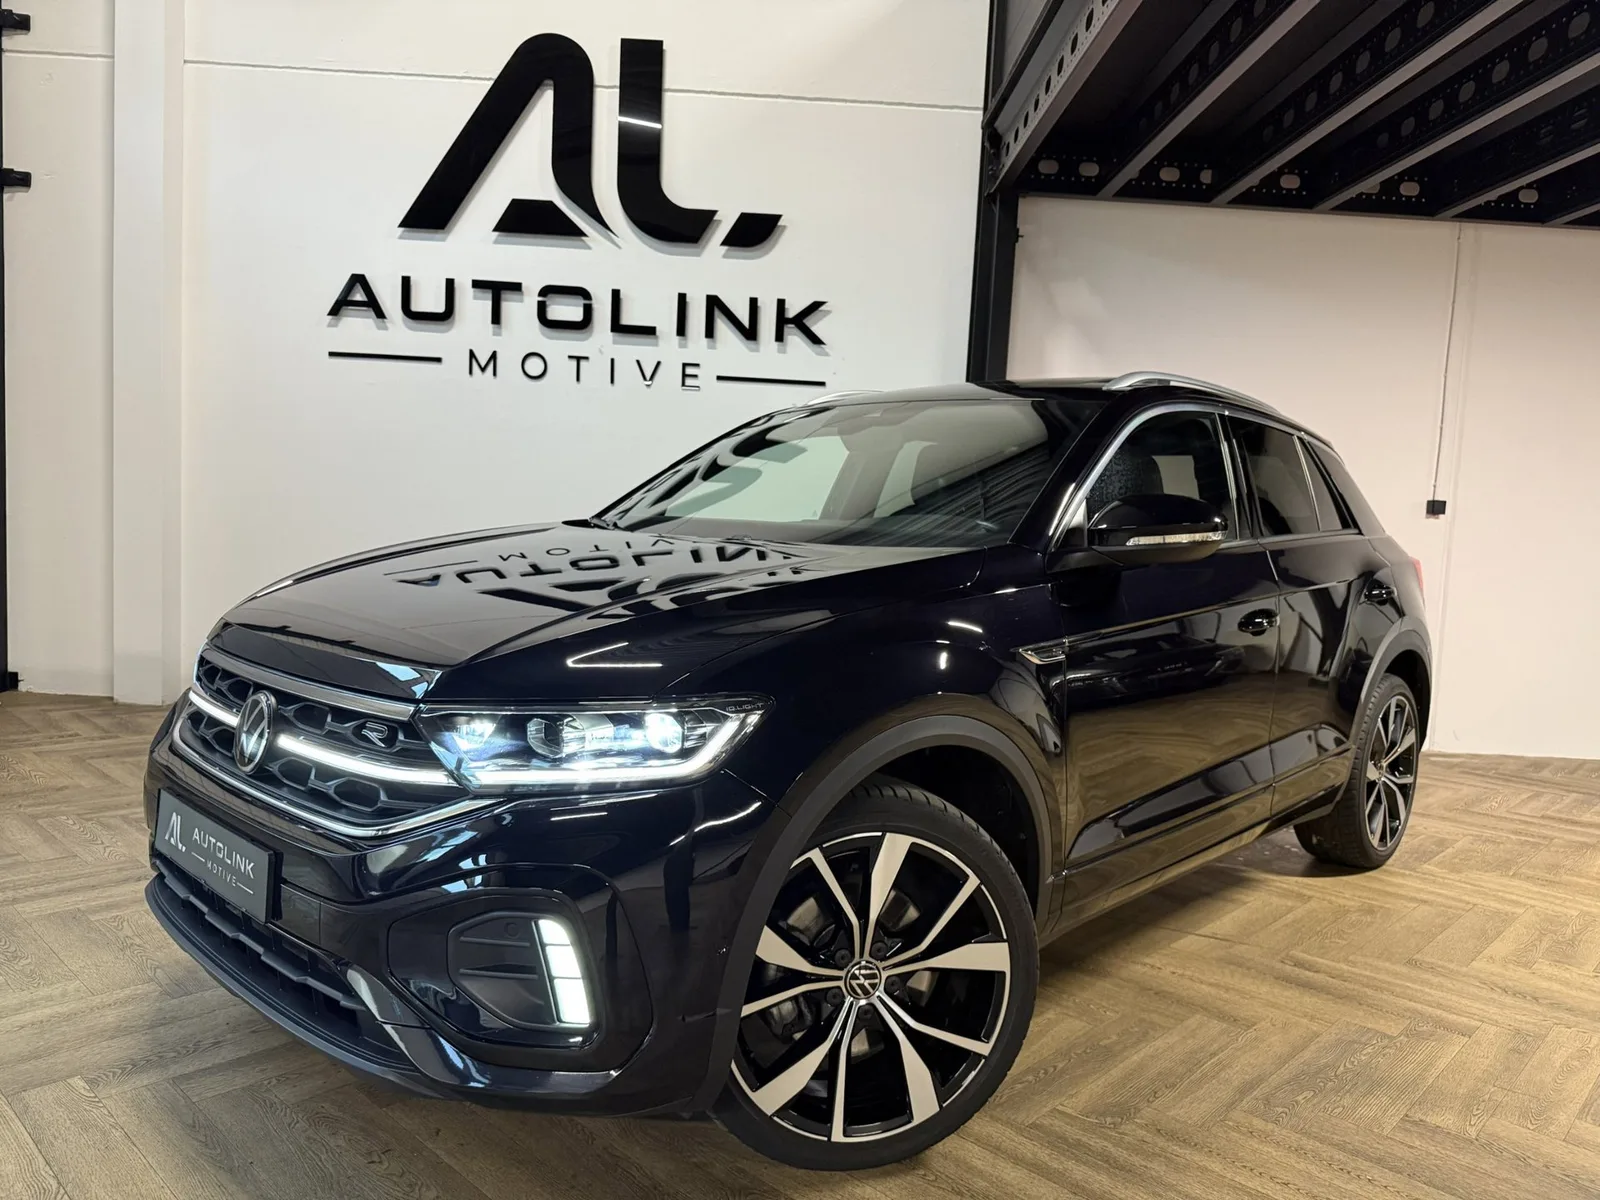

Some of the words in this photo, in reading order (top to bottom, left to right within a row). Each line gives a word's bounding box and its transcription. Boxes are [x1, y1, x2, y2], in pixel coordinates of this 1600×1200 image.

[327, 273, 829, 347] AUTOLINK
[468, 348, 701, 390] MOTIVE
[192, 827, 255, 879] AUTOLINK
[206, 859, 237, 887] MOTIVE
